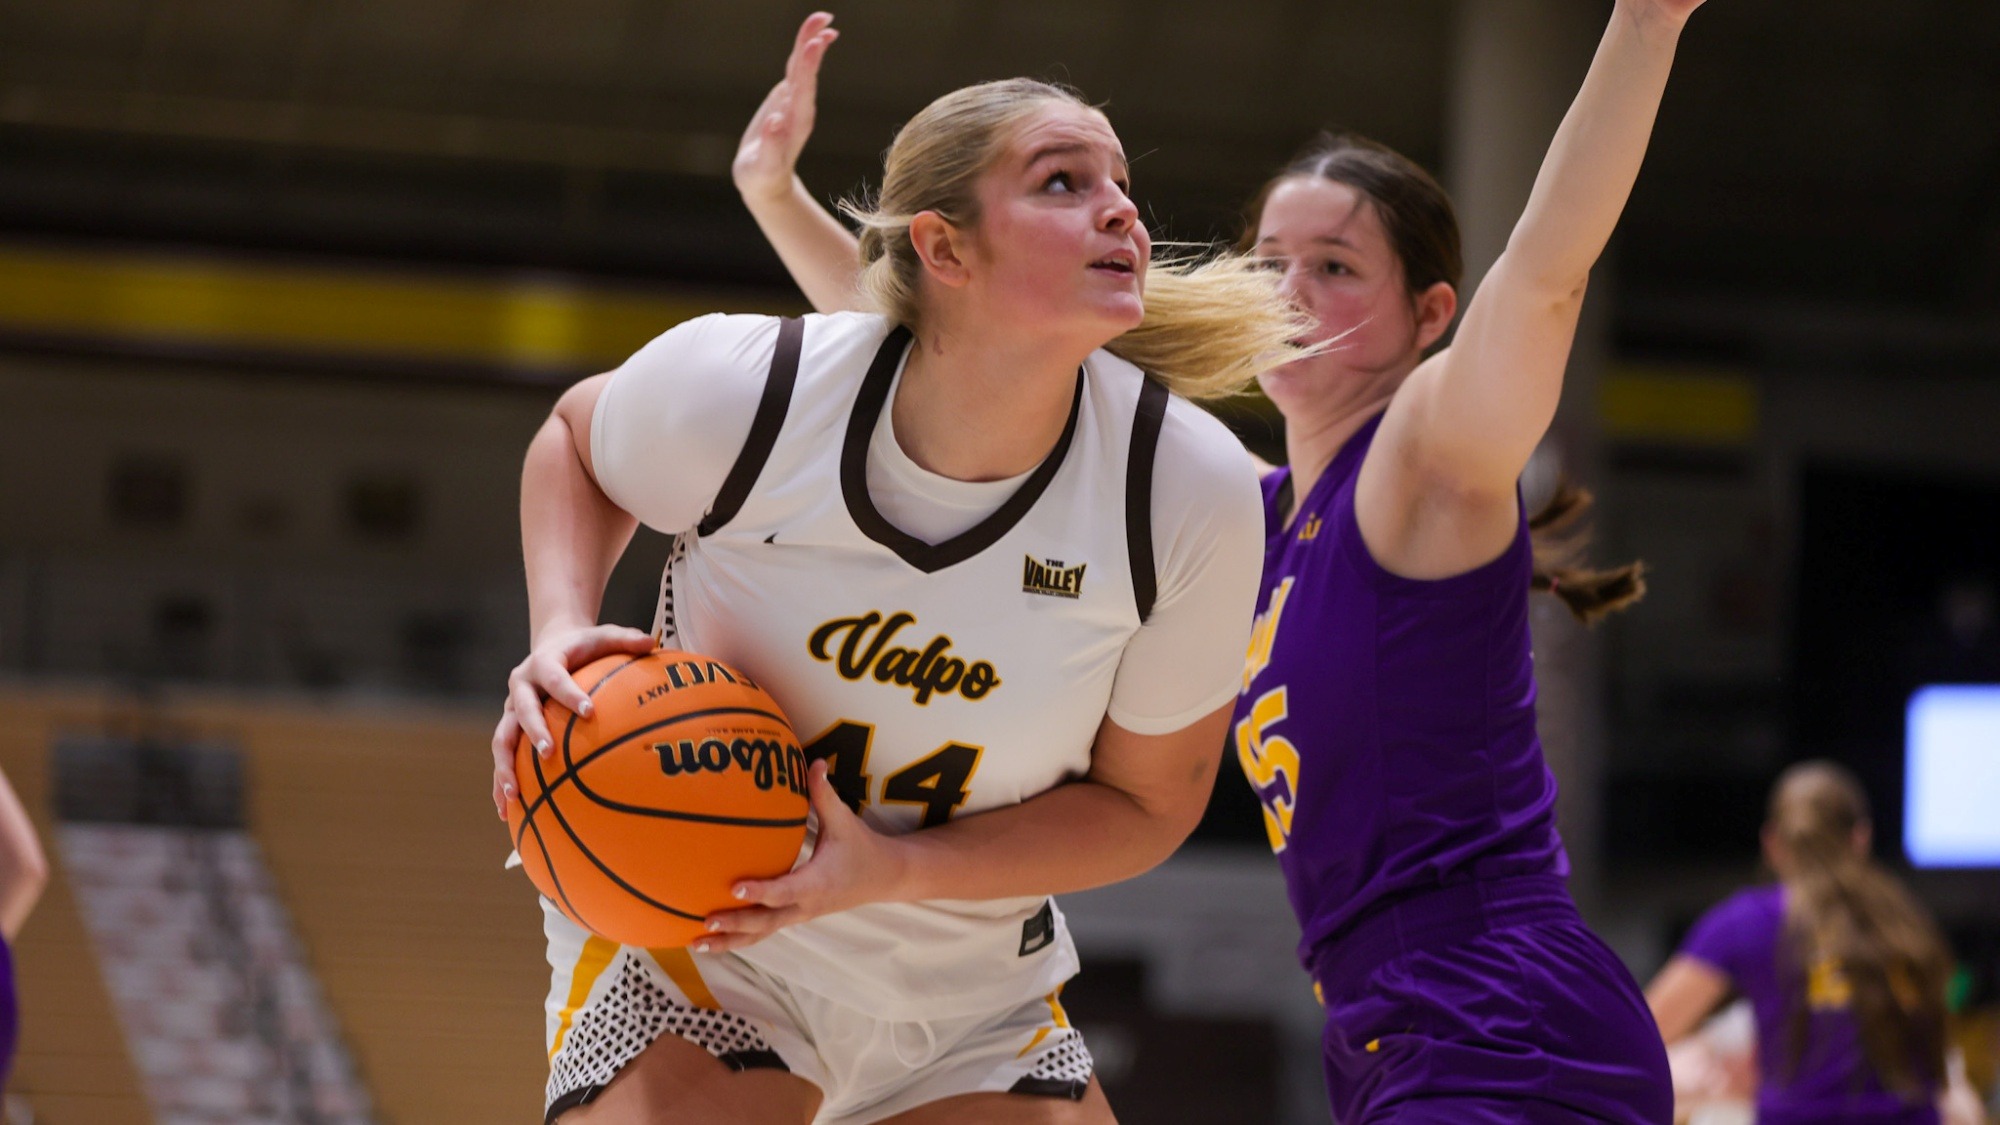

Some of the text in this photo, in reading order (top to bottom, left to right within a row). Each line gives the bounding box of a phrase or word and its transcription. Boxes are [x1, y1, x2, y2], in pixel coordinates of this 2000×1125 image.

[1023, 553, 1087, 594] VALLEY
[1045, 558, 1065, 569] THE
[806, 609, 1002, 707] Valpo
[636, 683, 671, 707] NXT
[653, 736, 809, 798] Wilson
[807, 718, 984, 829] 44
